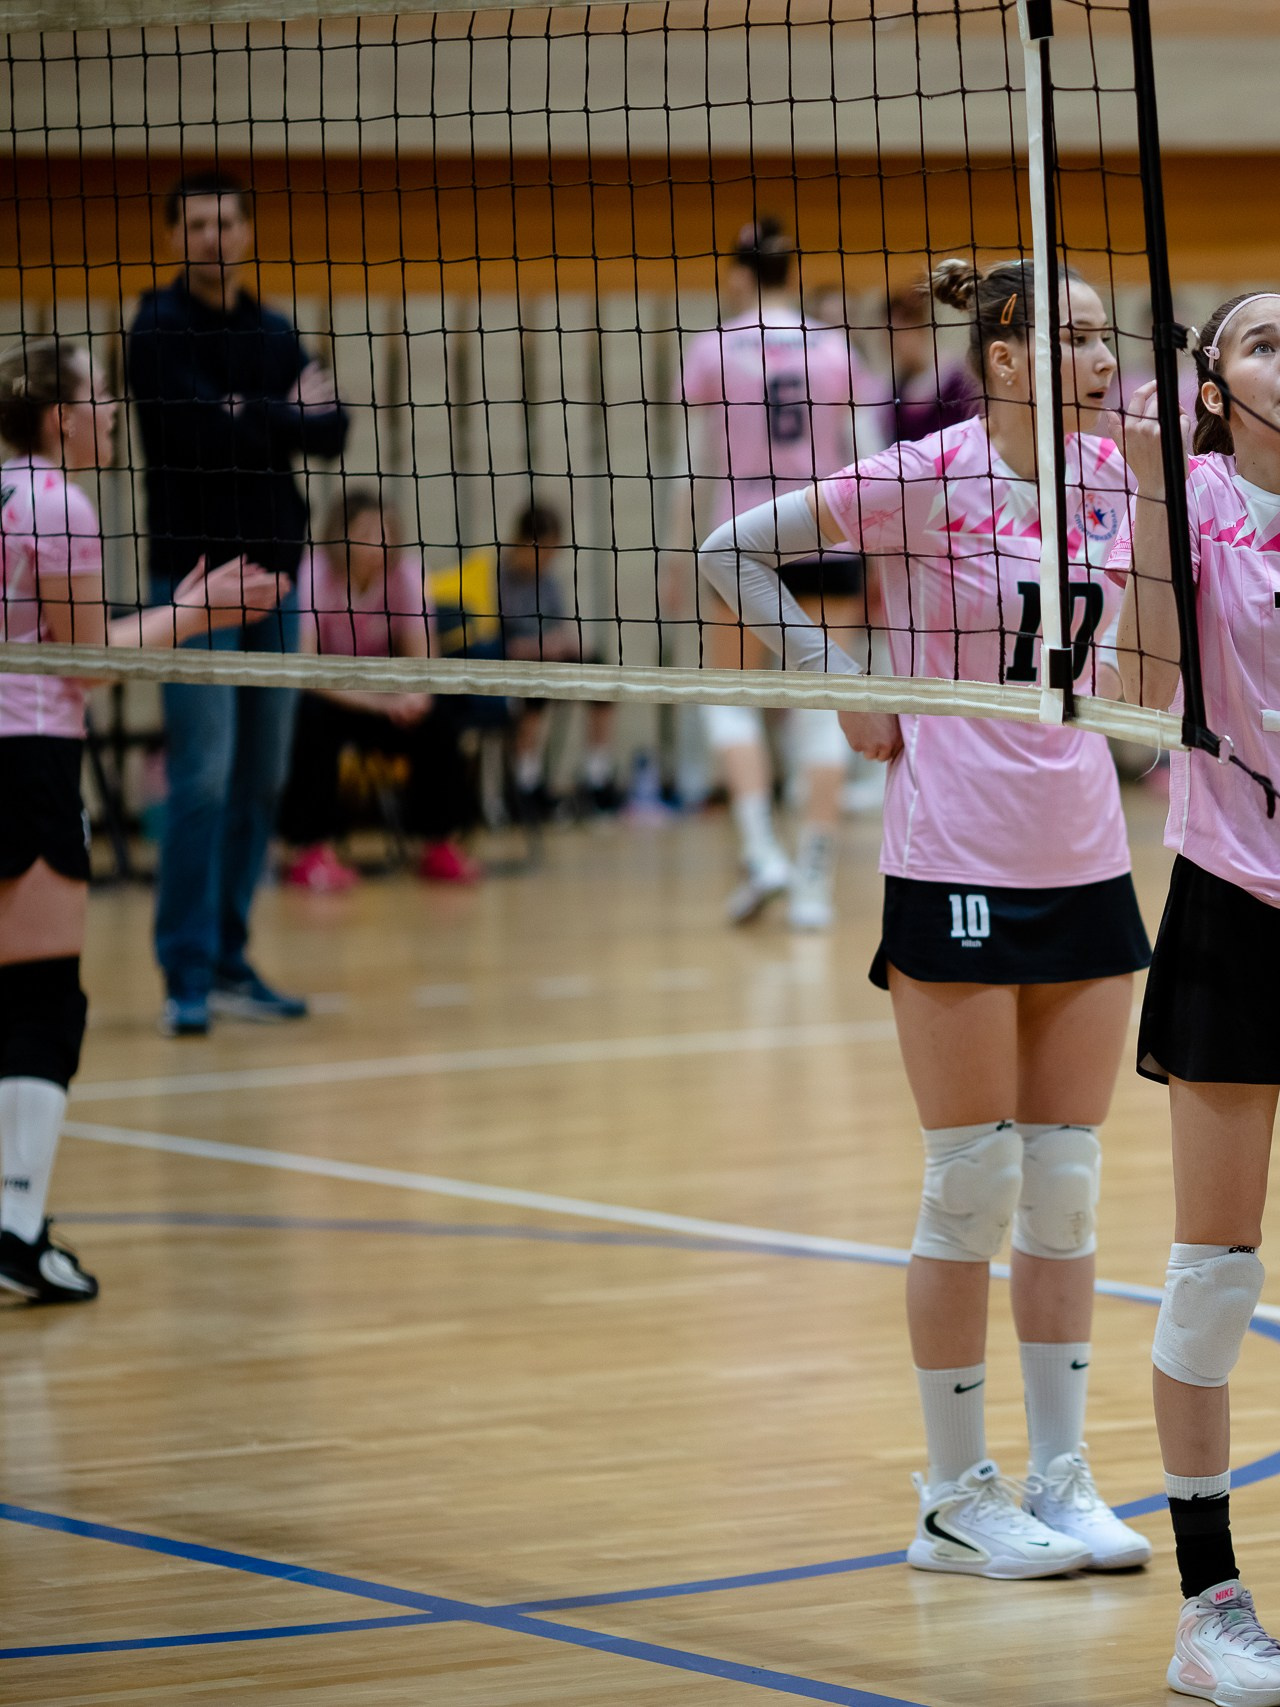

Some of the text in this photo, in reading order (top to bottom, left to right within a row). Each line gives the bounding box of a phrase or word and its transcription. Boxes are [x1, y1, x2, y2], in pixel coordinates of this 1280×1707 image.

[770, 373, 803, 442] 6
[1005, 581, 1104, 682] 10
[949, 894, 990, 938] 10
[1215, 1587, 1235, 1602] NIKE
